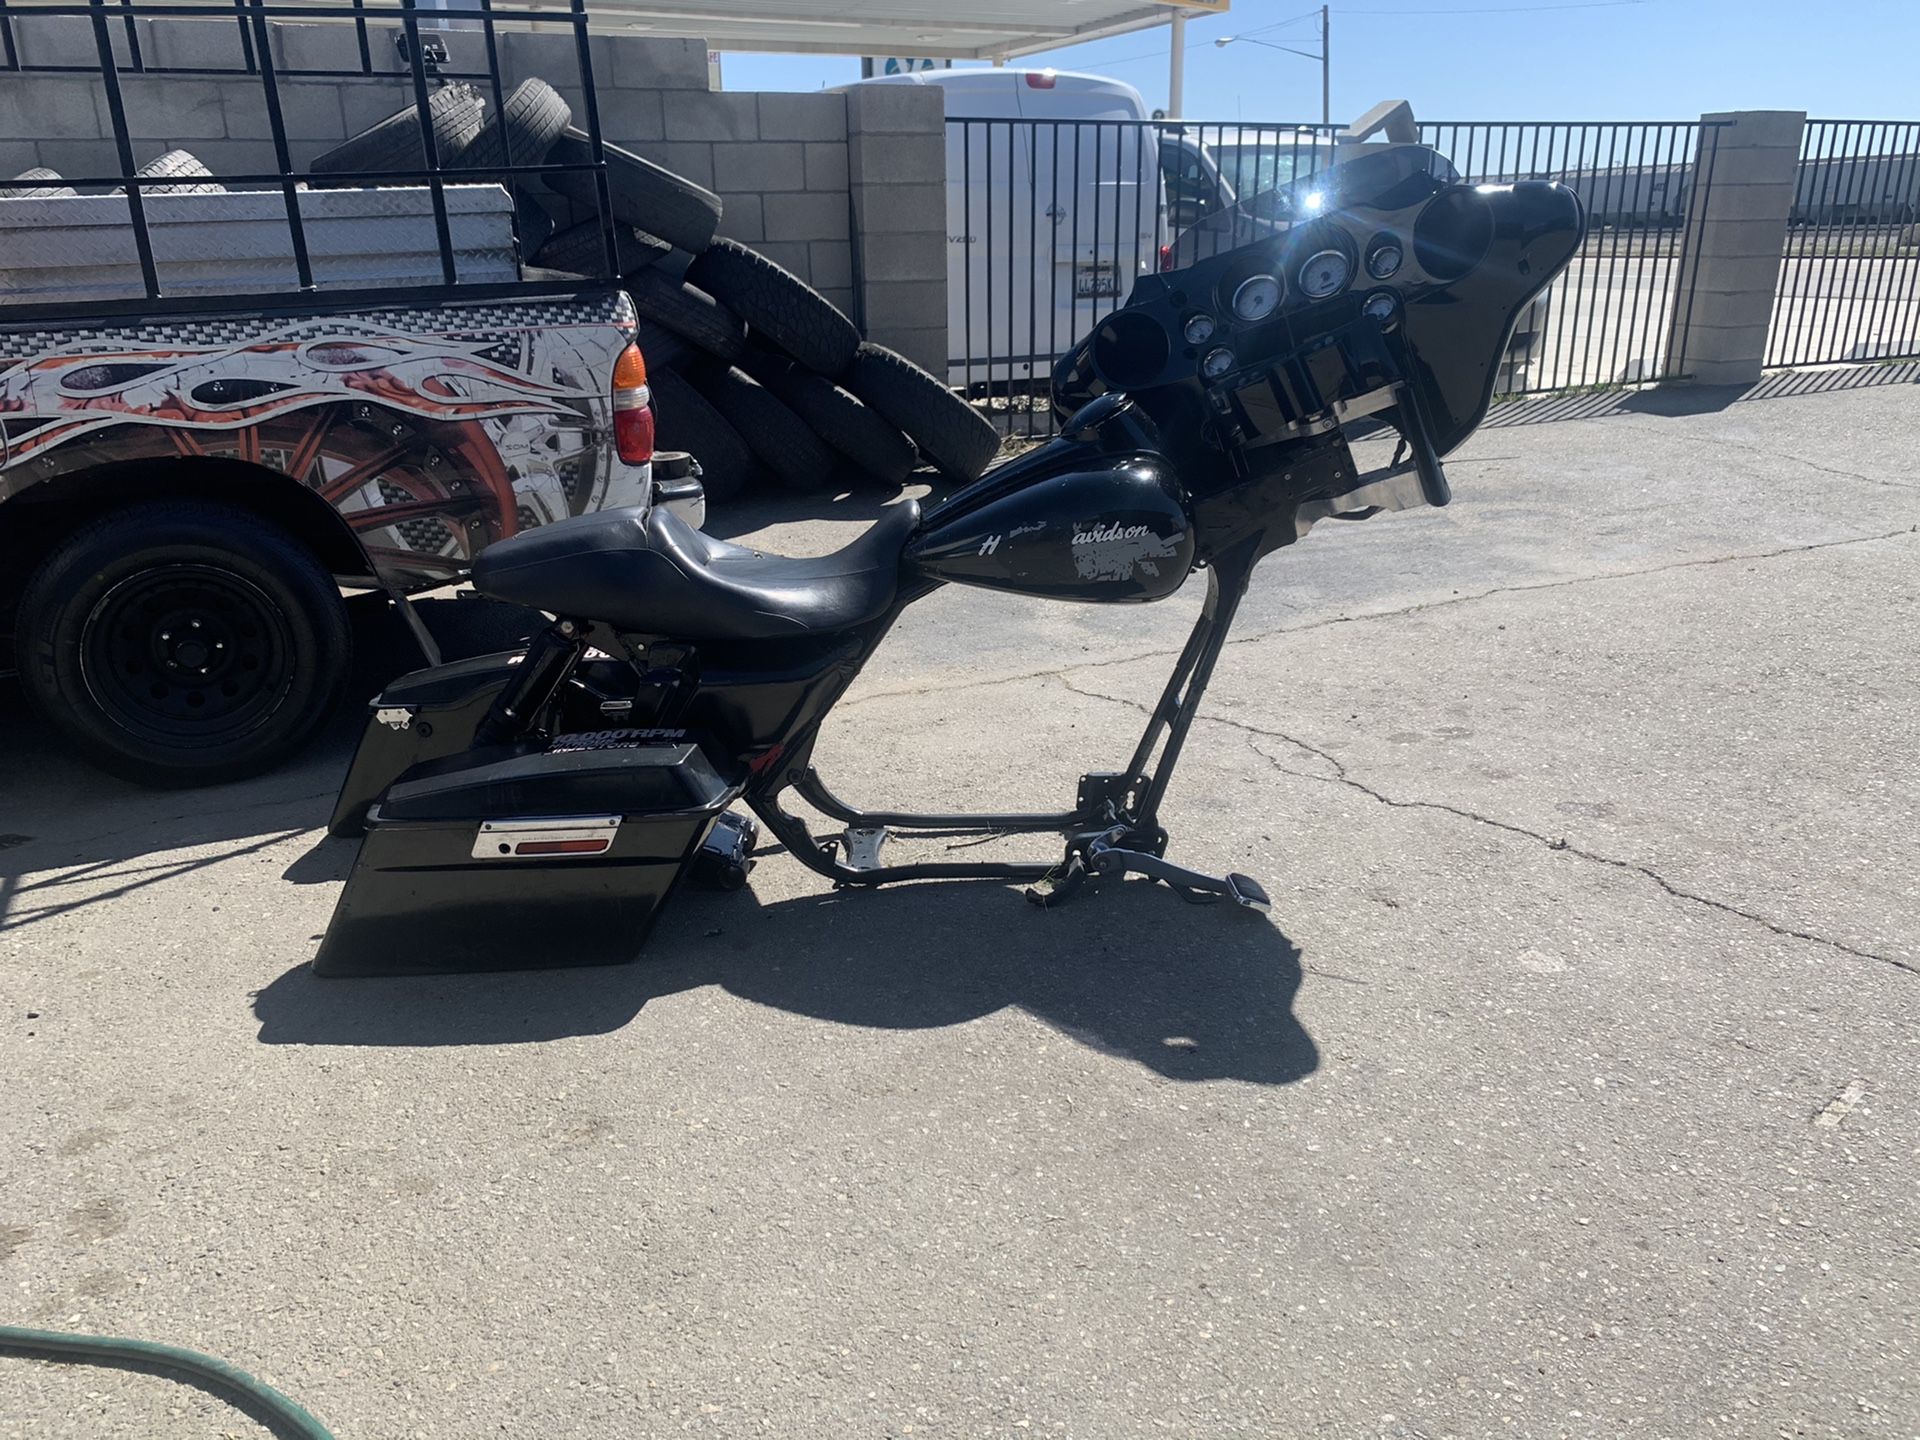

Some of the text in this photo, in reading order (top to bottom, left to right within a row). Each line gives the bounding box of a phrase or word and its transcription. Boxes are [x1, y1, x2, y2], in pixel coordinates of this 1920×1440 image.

[978, 521, 1149, 556] H avidson
[630, 728, 687, 739] RPM
